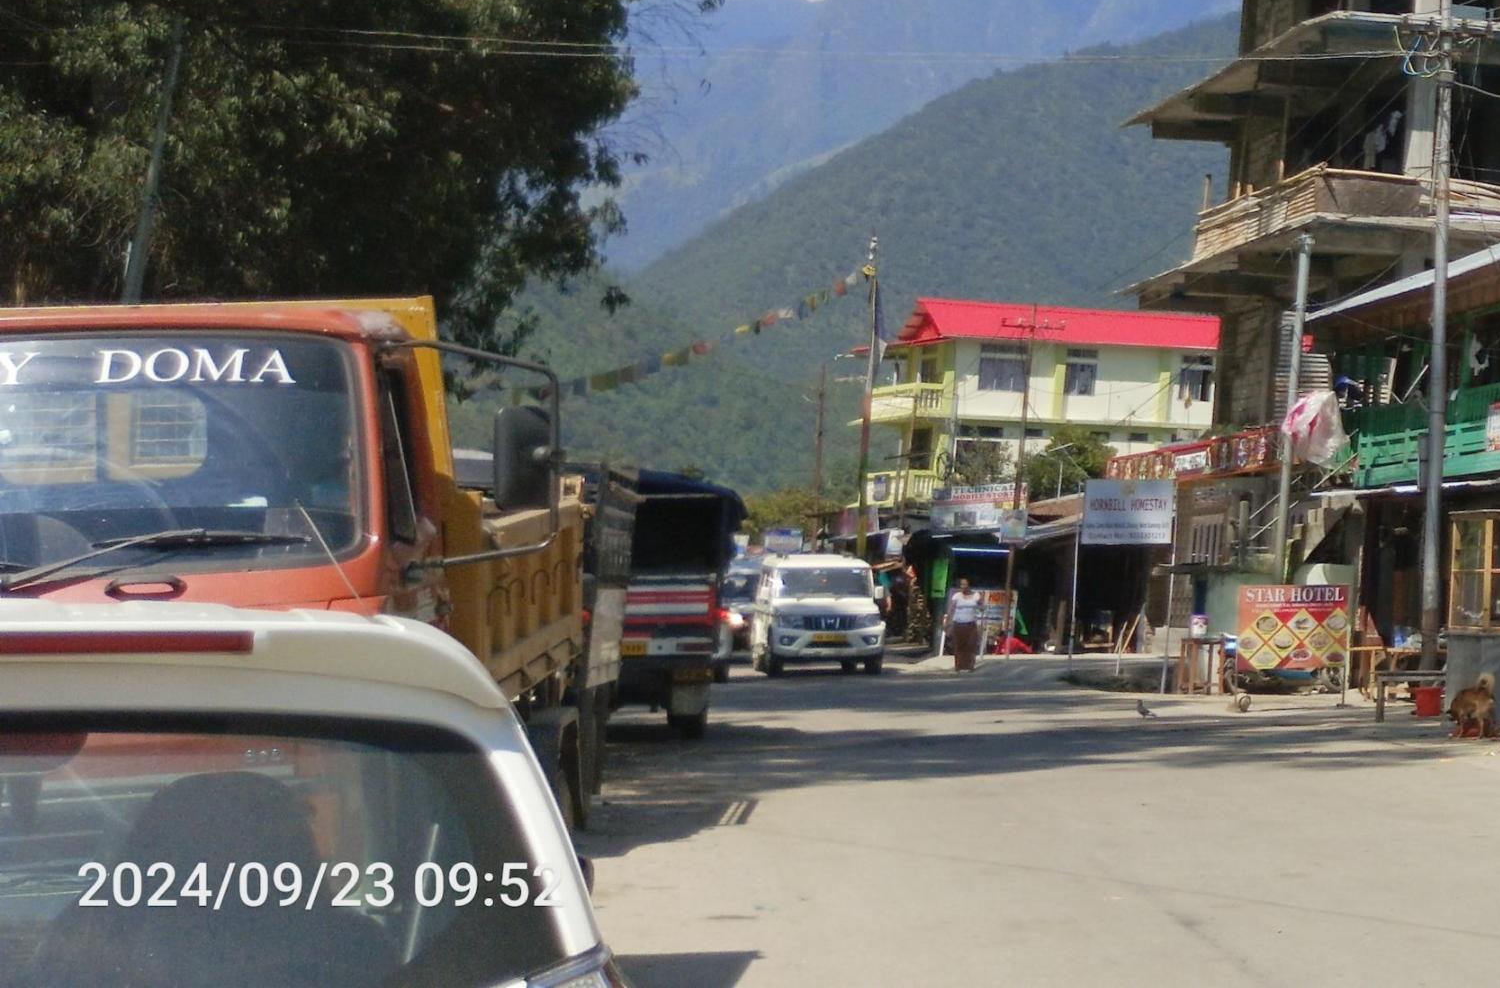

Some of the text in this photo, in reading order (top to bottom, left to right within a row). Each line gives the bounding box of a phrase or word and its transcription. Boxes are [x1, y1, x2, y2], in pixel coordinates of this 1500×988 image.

[0, 348, 297, 385] Y DOMA
[953, 484, 1016, 495] TECHNICAL
[1090, 498, 1168, 512] HORNBILL HOMESTAY
[1246, 587, 1344, 602] STAR HOTEL
